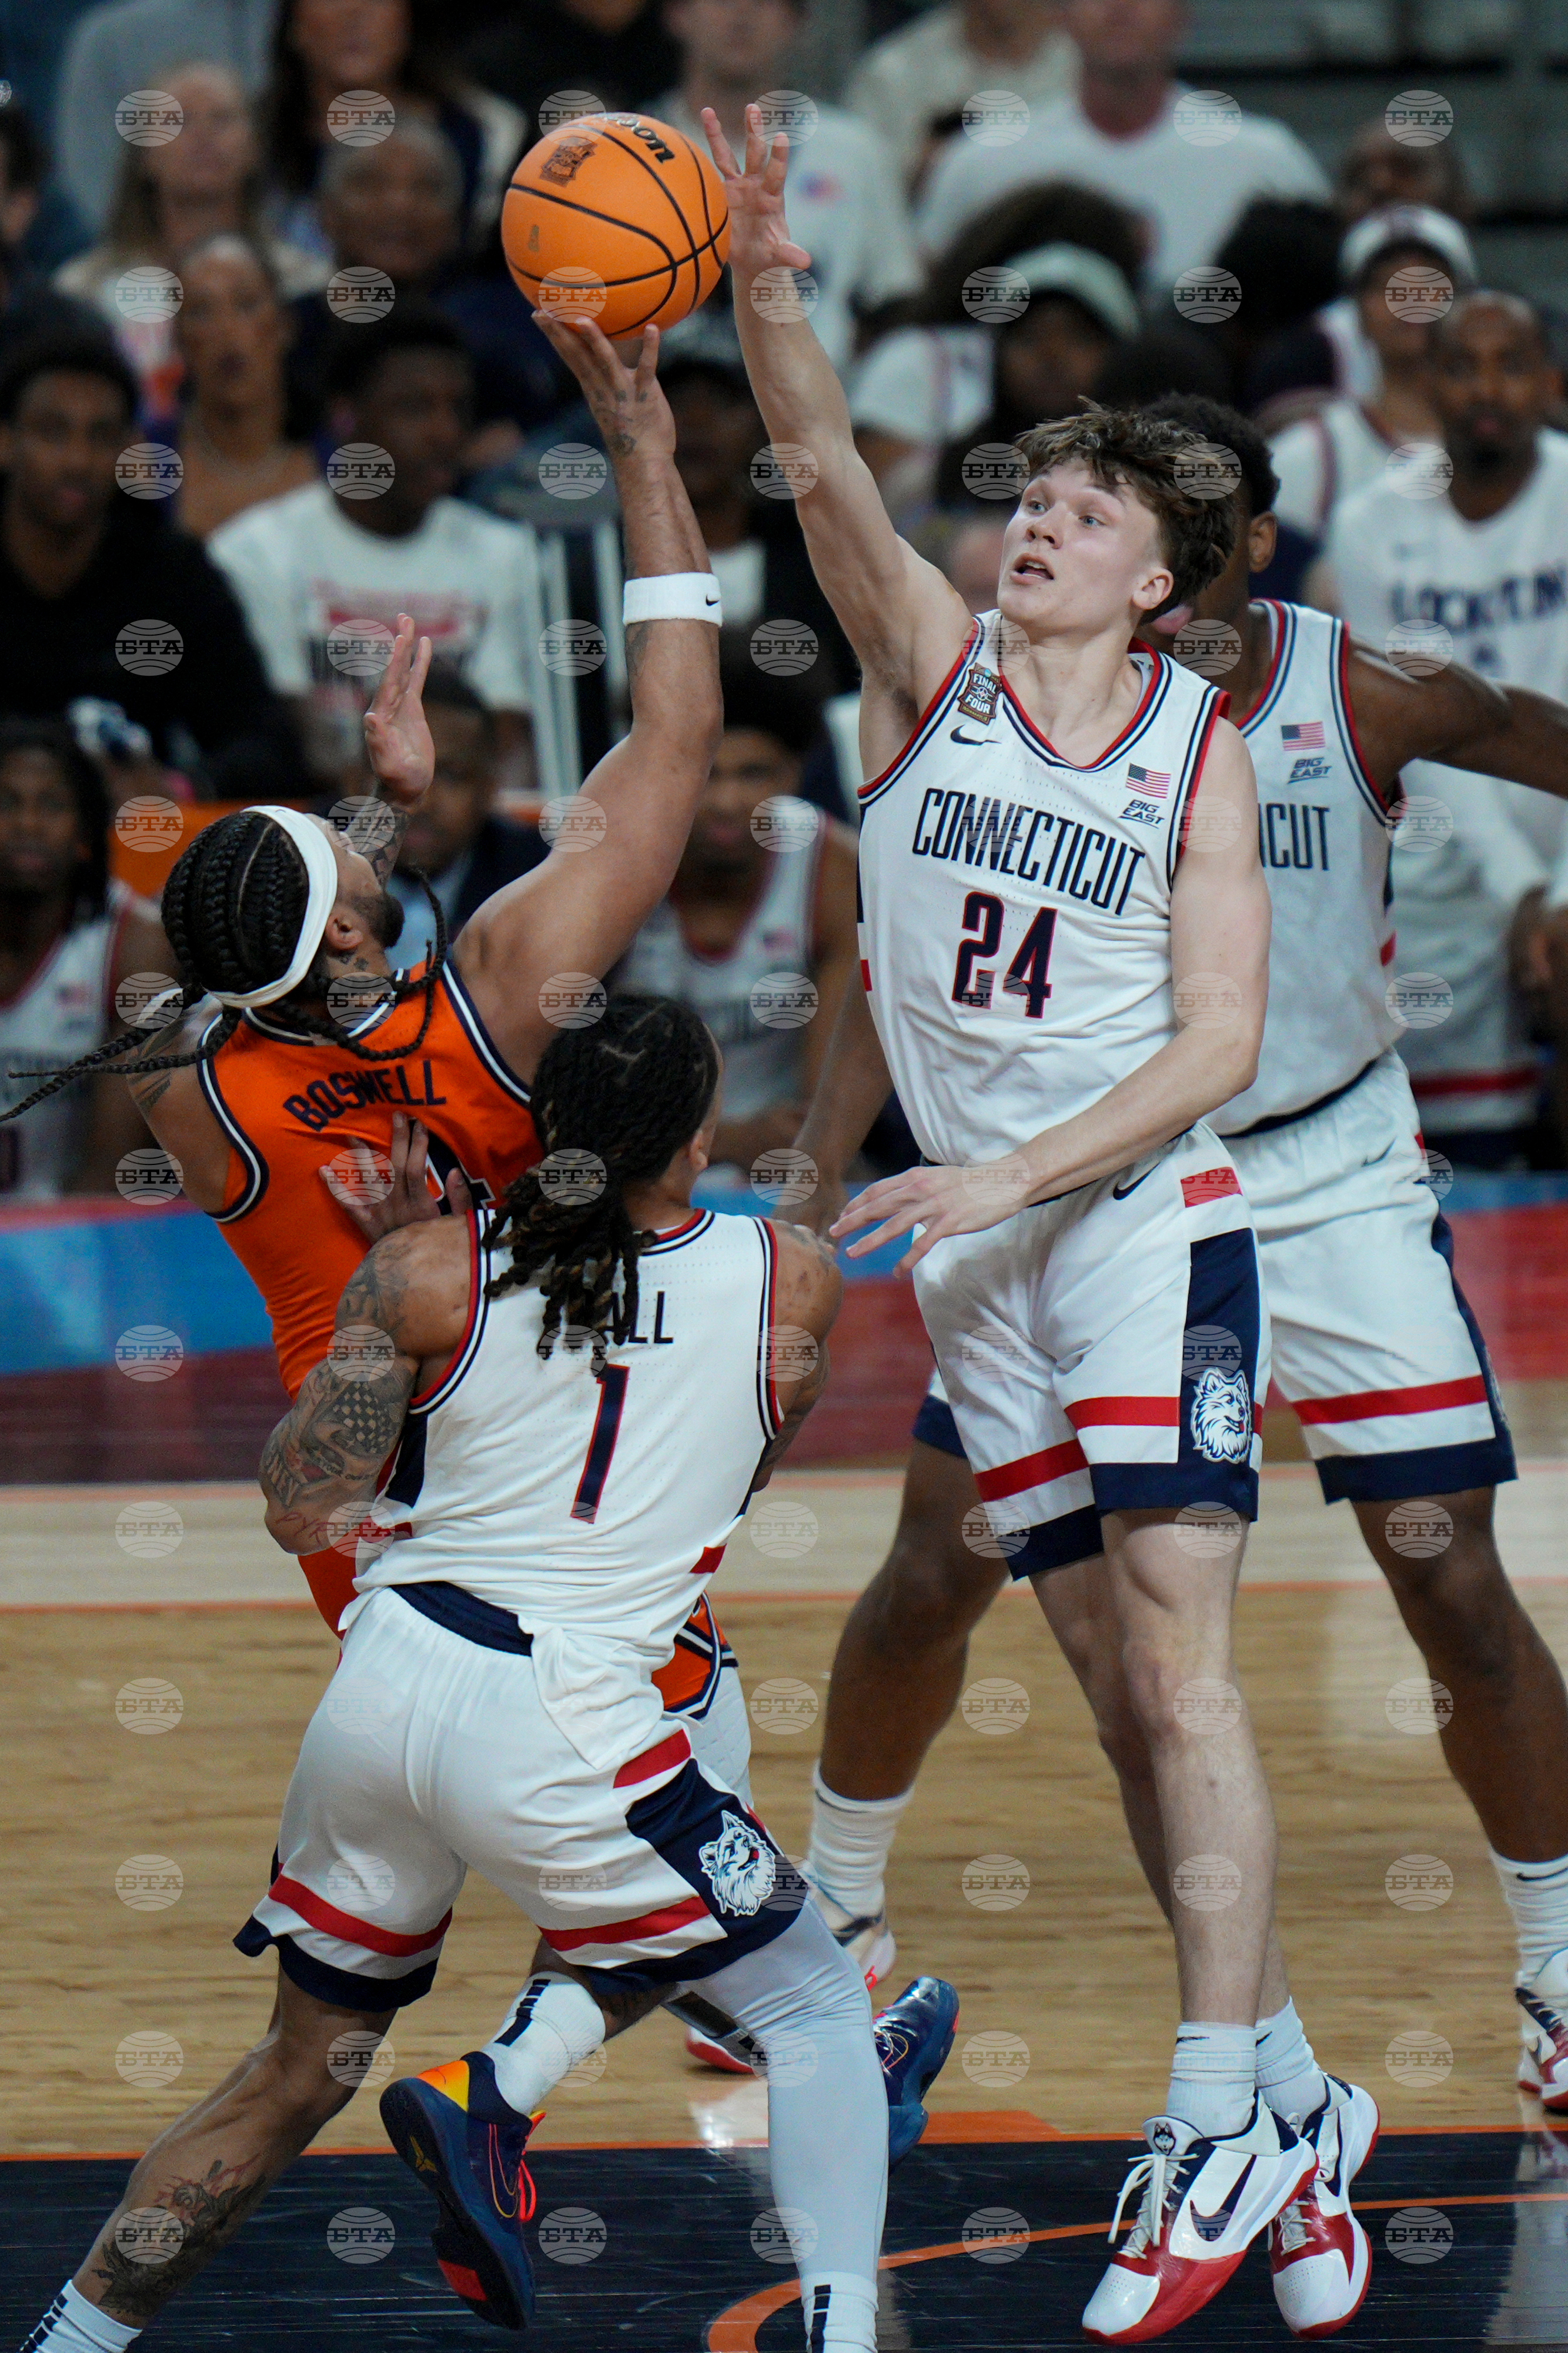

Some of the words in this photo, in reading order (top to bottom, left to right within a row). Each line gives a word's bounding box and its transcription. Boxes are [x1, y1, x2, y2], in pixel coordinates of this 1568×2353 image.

[973, 673, 997, 694] FINAL
[965, 694, 991, 715] FOUR
[1290, 766, 1332, 778] EAST
[1294, 757, 1325, 769] BIG
[1122, 807, 1165, 824] EAST
[1129, 799, 1160, 813] BIG
[912, 787, 1146, 916] CONNECTICUT
[951, 891, 1058, 1019] 24
[283, 1060, 446, 1132] BOSWELL
[570, 1363, 630, 1524] 1
